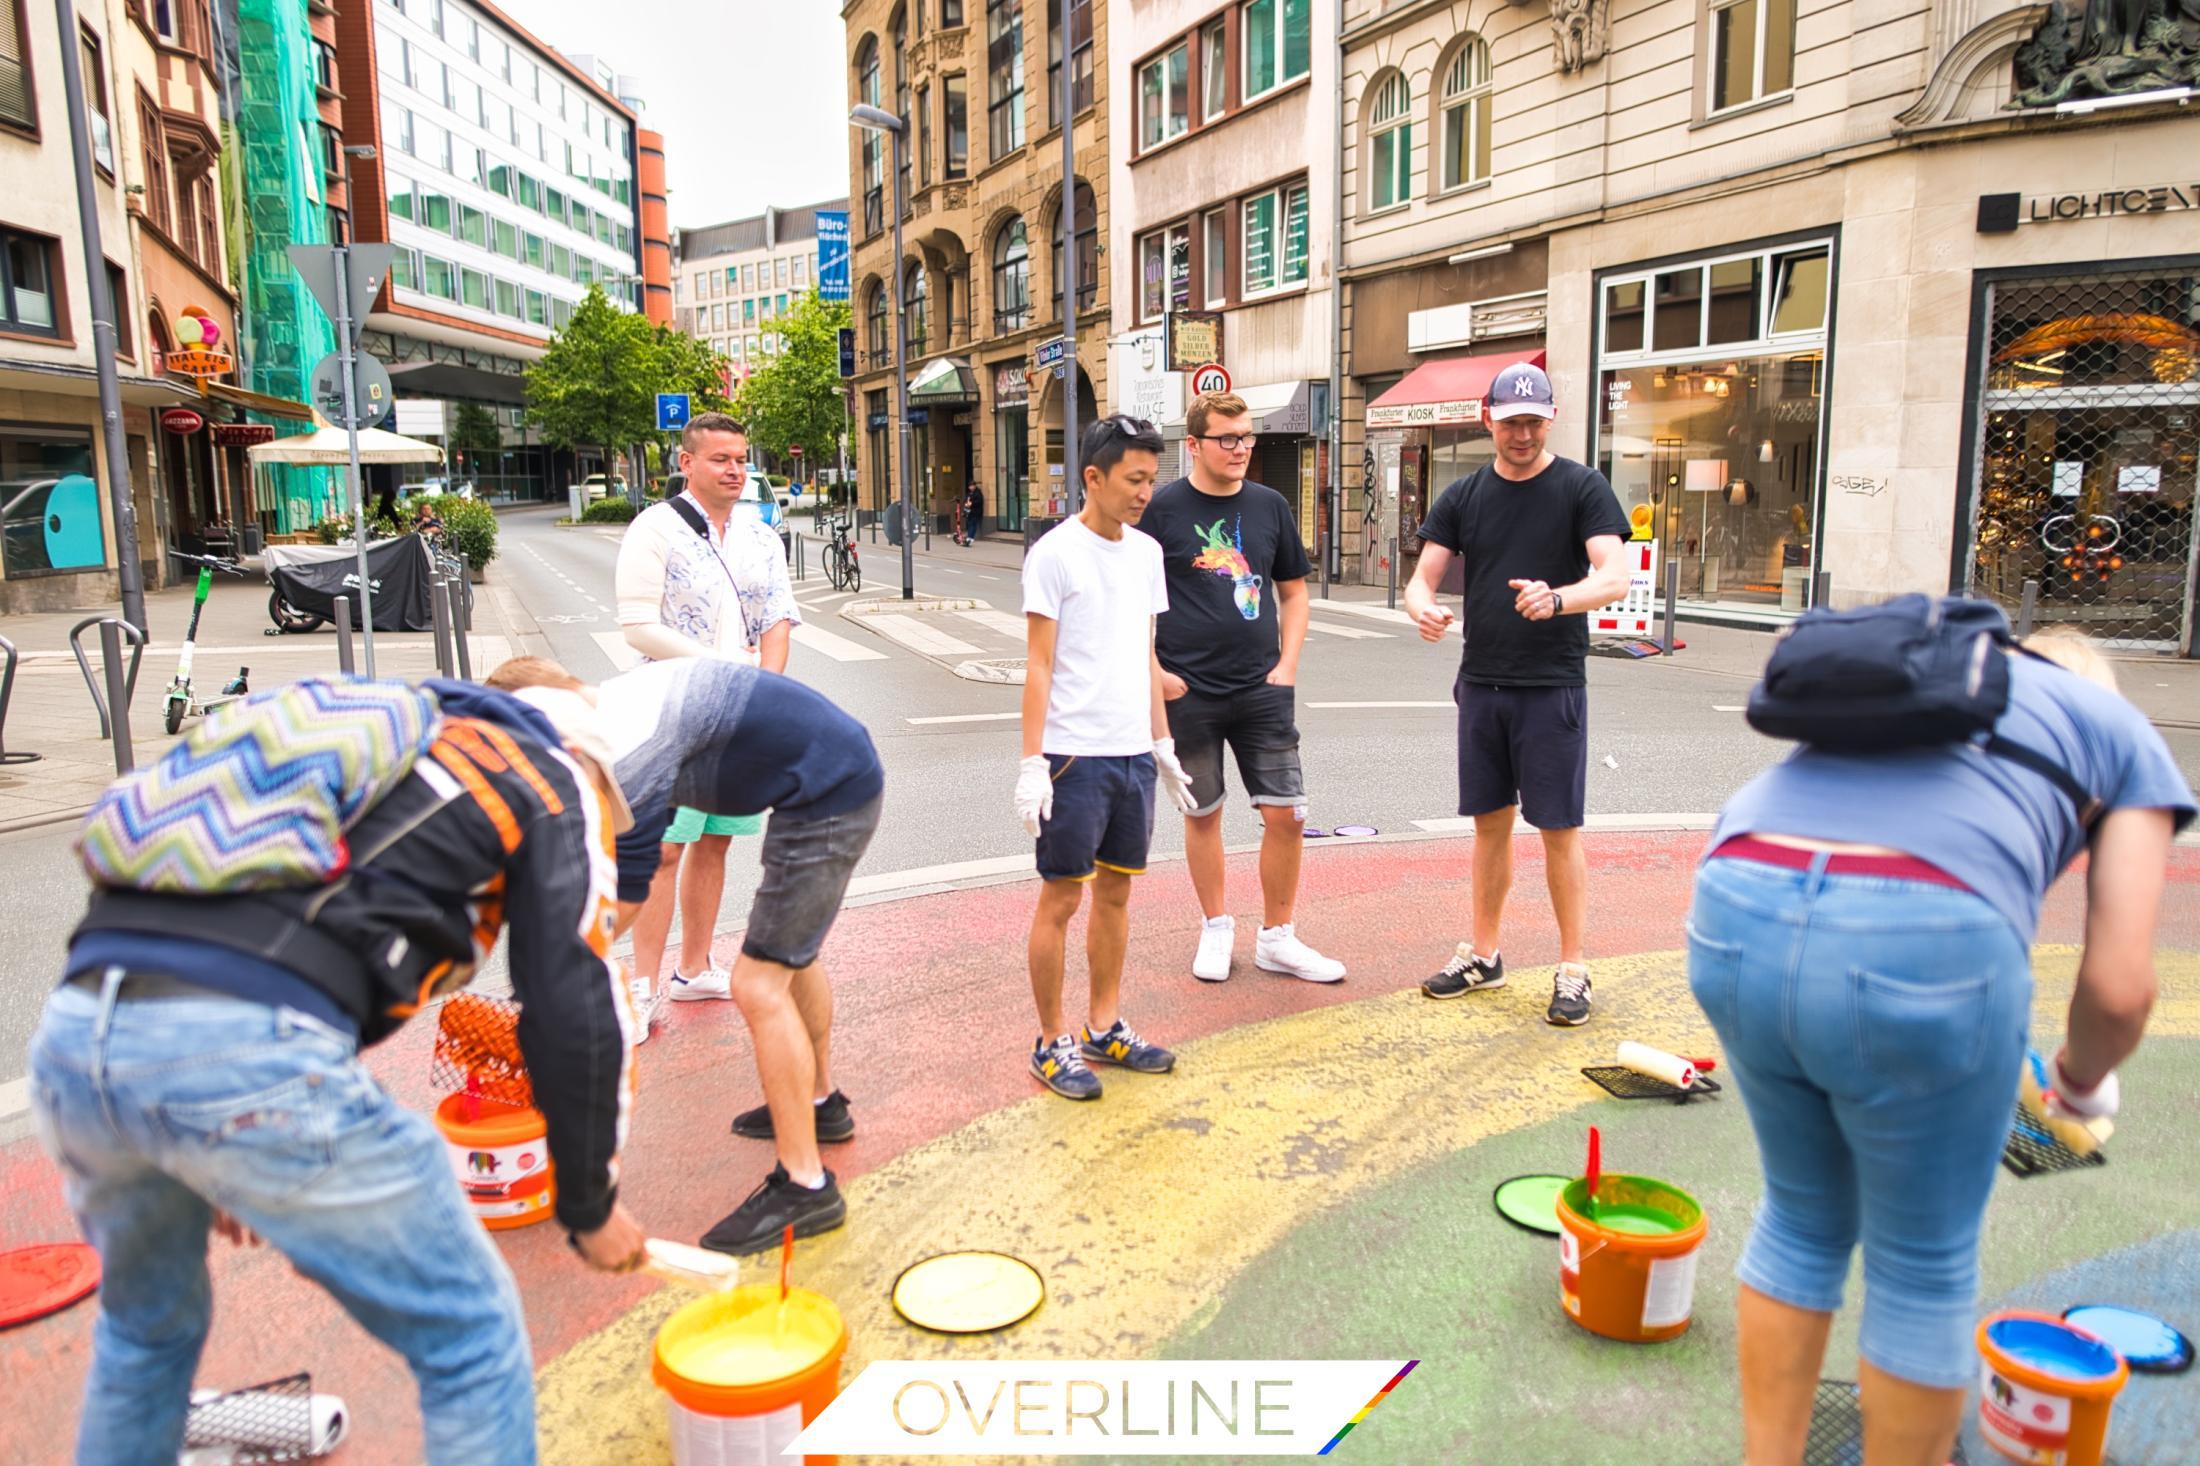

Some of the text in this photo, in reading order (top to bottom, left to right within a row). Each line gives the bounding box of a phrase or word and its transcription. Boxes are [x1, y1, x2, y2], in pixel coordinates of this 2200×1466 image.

[818, 217, 848, 231] Büro-
[170, 353, 226, 365] ITAL EIS
[182, 364, 216, 374] CAFE
[1201, 375, 1224, 392] 40
[1515, 376, 1533, 397] NY
[1609, 380, 1632, 391] LIVING
[1610, 391, 1623, 401] THE
[1371, 403, 1476, 421] Frankfurter KIOSK Frankfurter
[1609, 400, 1629, 411] LIGHT
[1105, 1040, 1131, 1061] N
[1041, 1057, 1061, 1079] N
